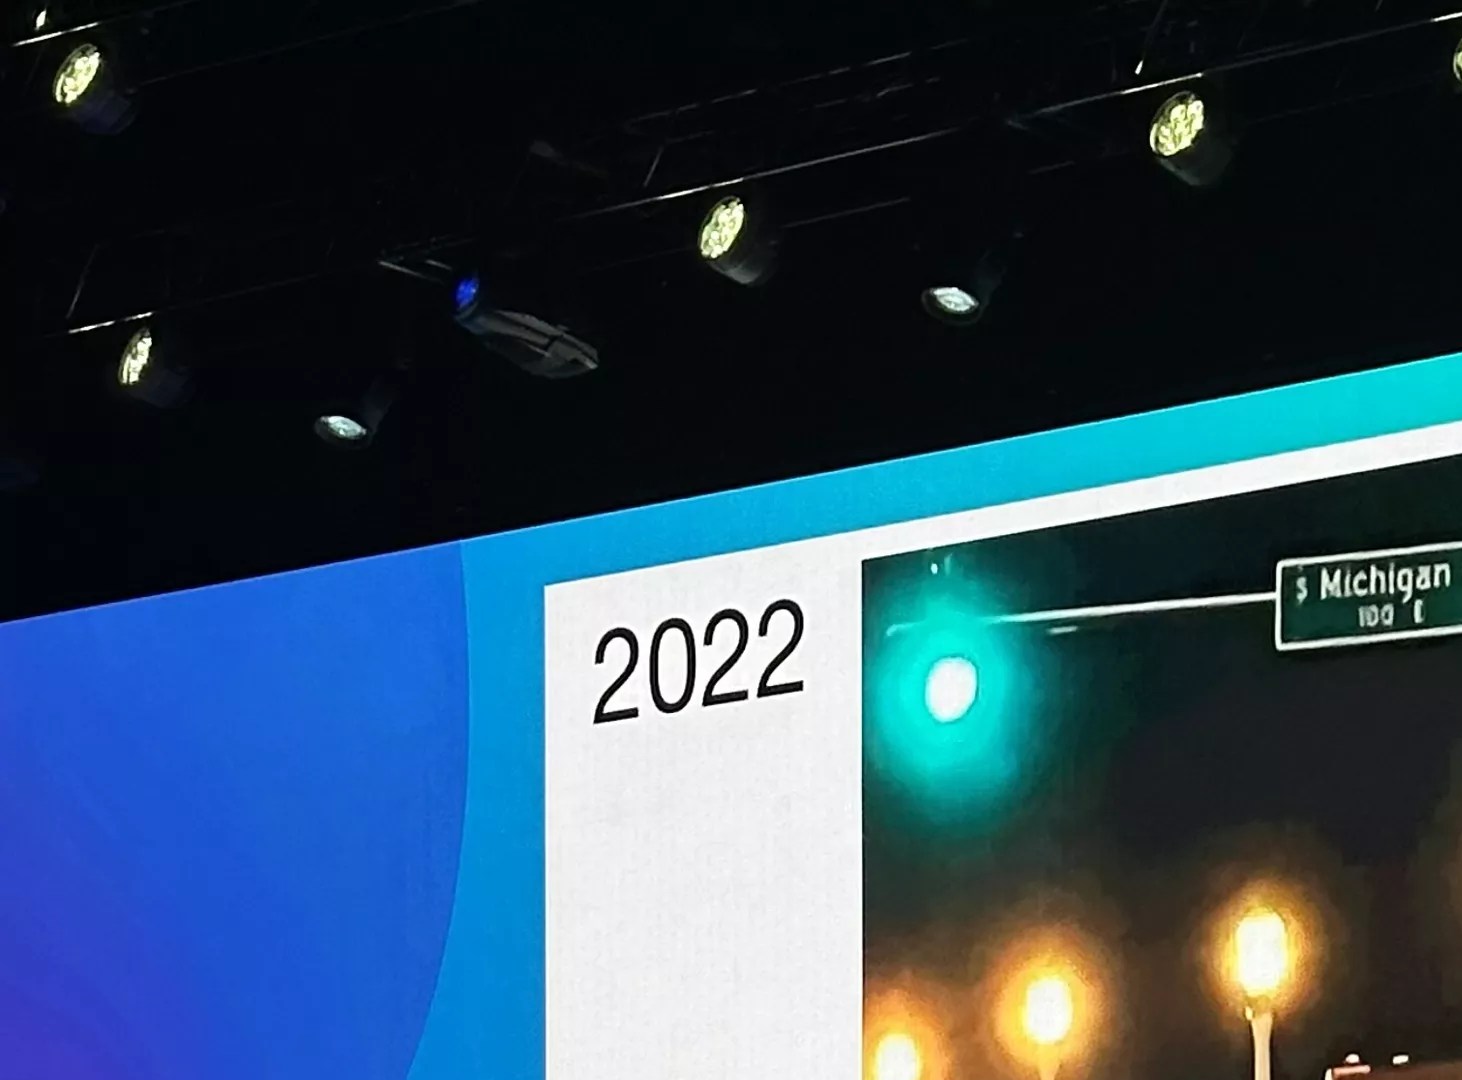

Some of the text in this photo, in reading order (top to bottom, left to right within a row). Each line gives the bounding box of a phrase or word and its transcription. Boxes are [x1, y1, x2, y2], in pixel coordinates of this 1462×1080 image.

[1295, 575, 1309, 605] S
[1319, 561, 1452, 605] Michigan
[593, 598, 804, 724] 2022
